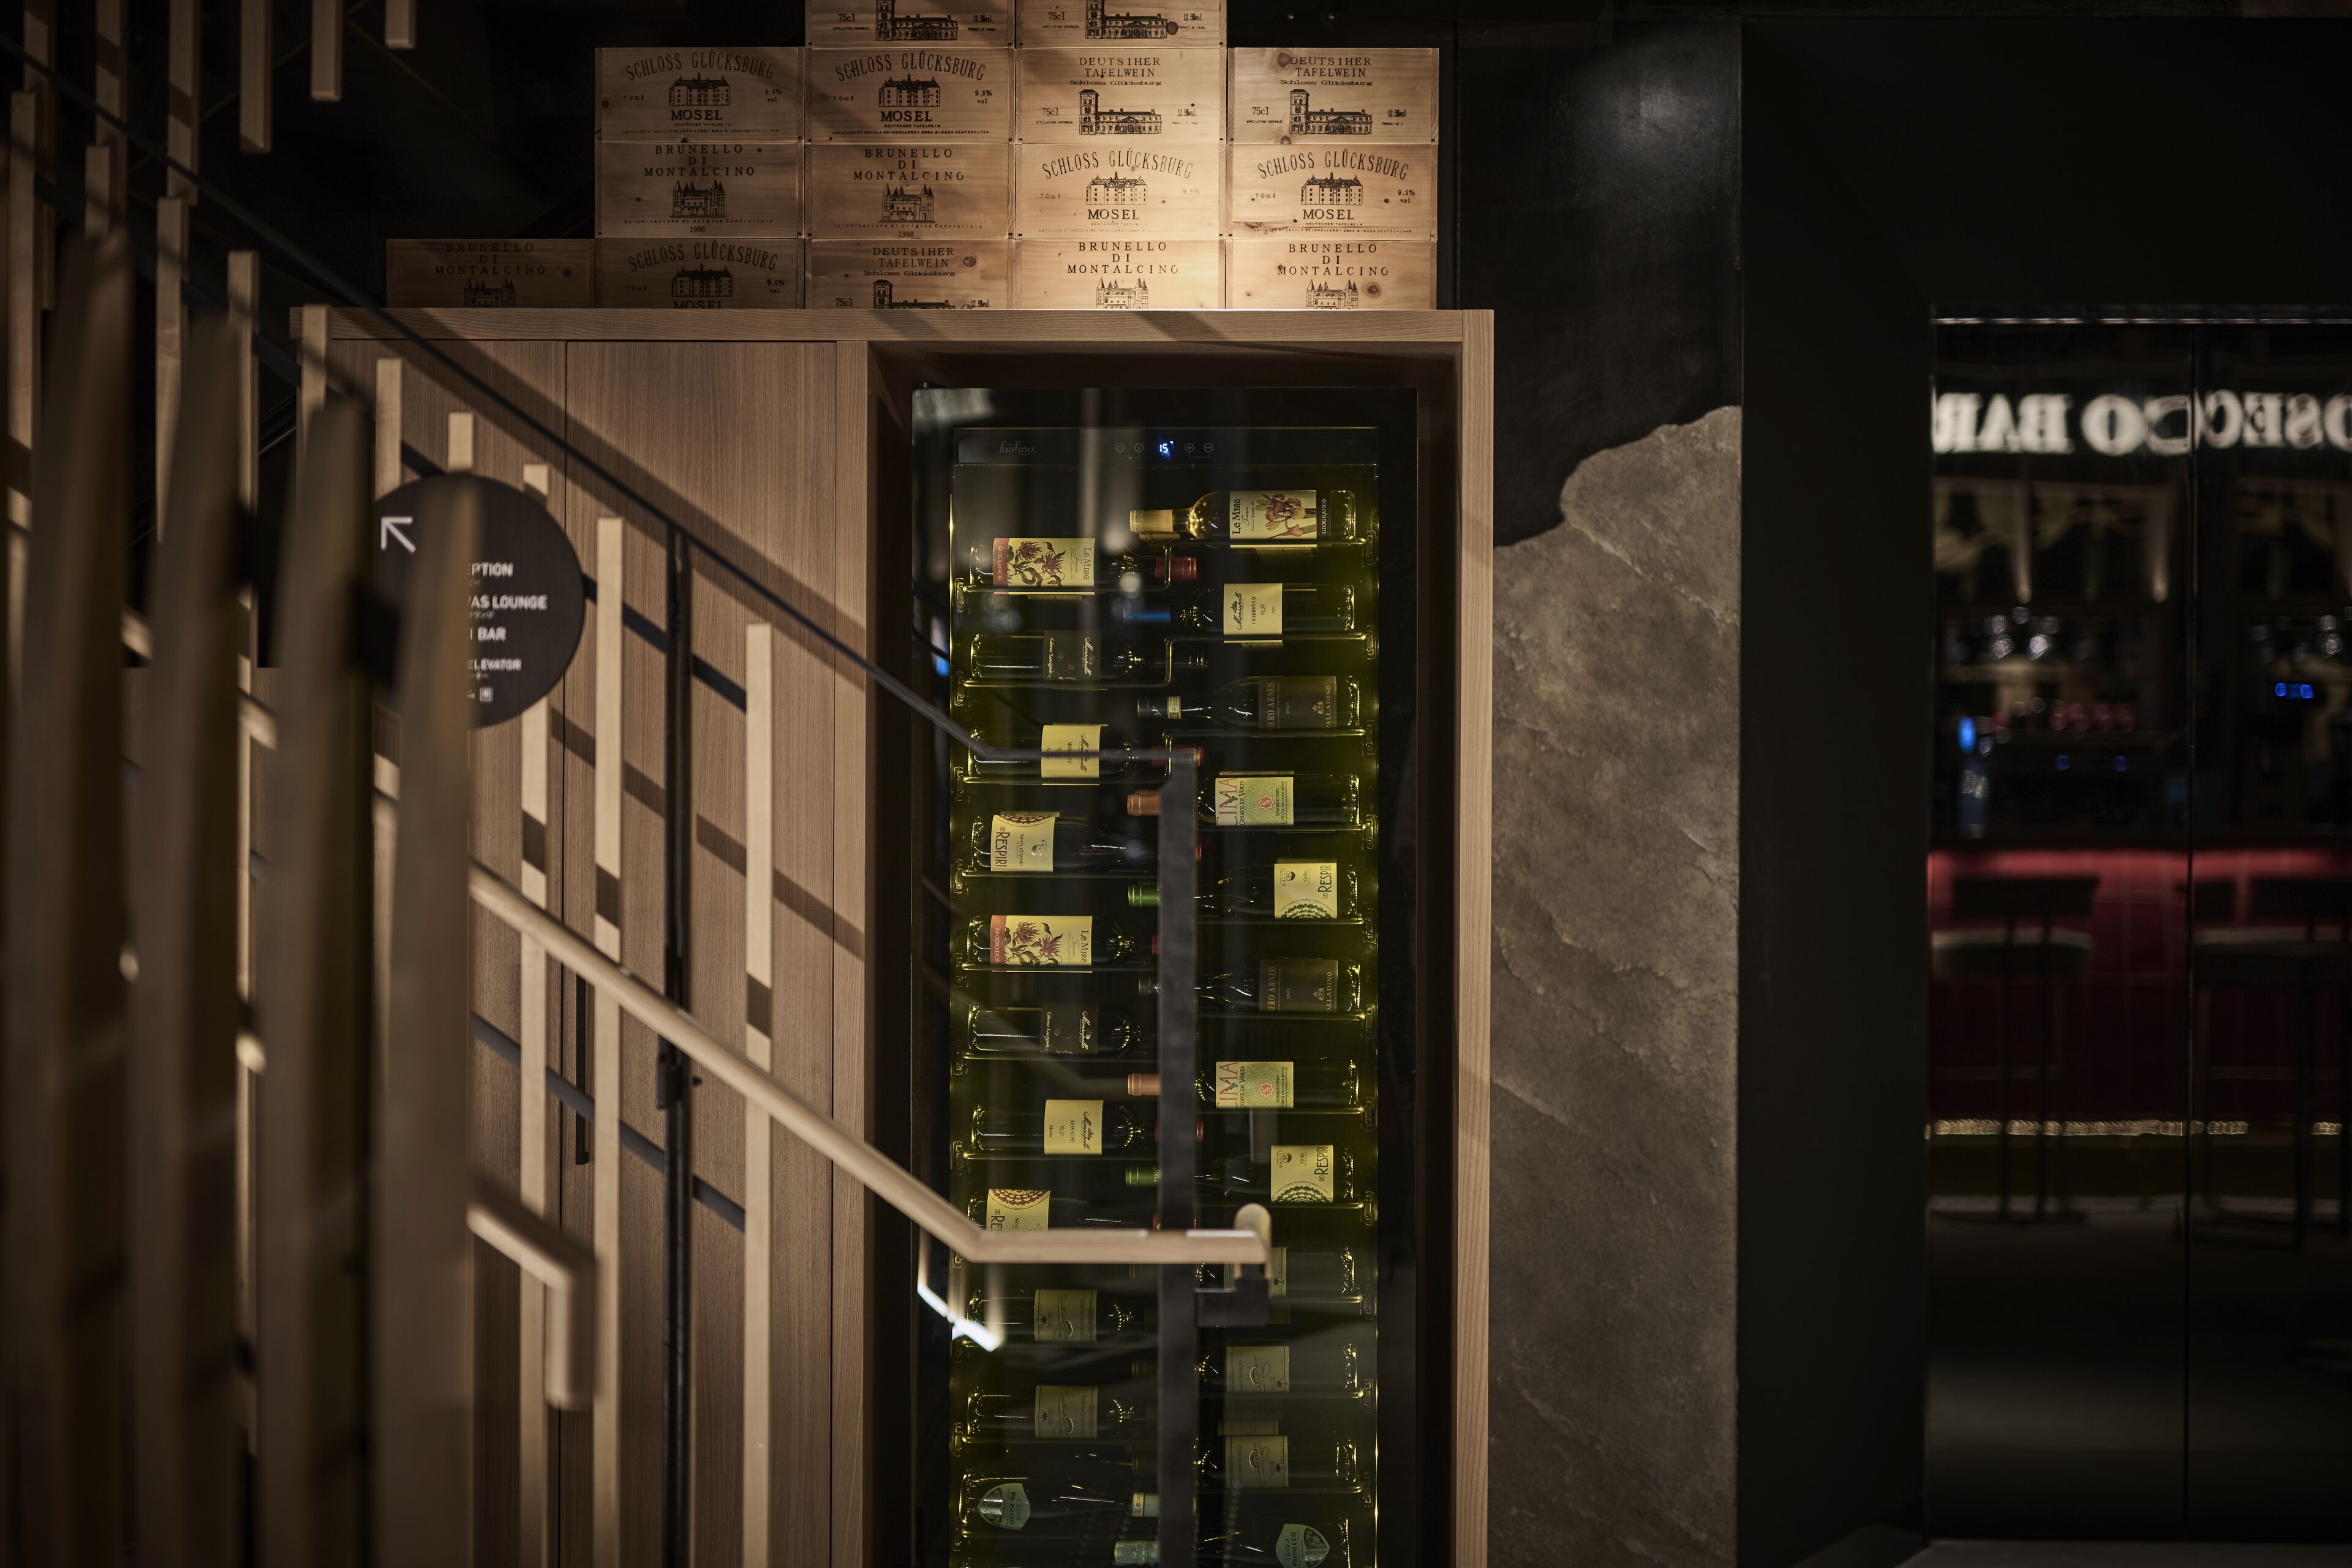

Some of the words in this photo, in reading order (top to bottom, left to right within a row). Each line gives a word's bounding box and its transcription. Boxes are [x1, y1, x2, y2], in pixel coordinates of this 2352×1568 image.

[839, 13, 855, 22] 75cl
[1048, 12, 1065, 20] 75cl
[626, 53, 682, 81] SCHLOSS
[692, 49, 775, 79] GLÜCKSBURG
[835, 53, 892, 81] SCHLOSS
[902, 50, 986, 81] GLÜCKSBURG
[1079, 57, 1160, 66] DEUTSIHER
[1290, 57, 1371, 66] DEUTSIHER
[1085, 68, 1155, 78] TAFELWEIN
[1295, 67, 1366, 77] TAFELWEIN
[671, 110, 723, 121] MOSEL
[881, 111, 932, 121] MOSEL
[1042, 107, 1059, 116] 75cl
[1252, 107, 1270, 116] 75cl
[655, 145, 742, 154] BRUNELLO
[865, 148, 952, 157] BRUNELLO
[688, 156, 706, 165] DI
[898, 160, 916, 169] DI
[1042, 151, 1099, 179] SCHLOSS
[1109, 148, 1193, 179] GLÜCKSBURG
[1257, 152, 1314, 179] SCHLOSS
[1325, 148, 1408, 180] GLÜCKSBURG
[644, 167, 755, 176] MONTALCINO
[853, 171, 964, 181] MONTALCINO
[1087, 209, 1139, 220] MOSEL
[1303, 208, 1354, 220] MOSEL
[446, 243, 533, 252] BRUNELLO
[1079, 241, 1167, 251] BRUNELLO
[1288, 243, 1377, 253] BRUNELLO
[628, 244, 684, 272] SCHLOSS
[695, 239, 778, 270] GLÜCKSBURG
[873, 247, 954, 256] DEUTSIHER
[480, 254, 497, 263] DI
[879, 258, 949, 268] TAFELWEIN
[1112, 254, 1131, 263] DI
[1322, 255, 1340, 264] DI
[435, 265, 545, 274] MONTALCINO
[1067, 265, 1179, 274] MONTALCINO
[1277, 266, 1389, 276] MONTALCINO
[835, 298, 853, 307] 75cl
[468, 562, 513, 576] PTION
[492, 594, 548, 610] LOUNGE
[1233, 592, 1244, 630] Monsupello
[478, 627, 507, 641] BAR
[1082, 637, 1093, 676] Monsupello
[468, 658, 522, 671] ELEVATOR
[995, 832, 1010, 867] RESPIRI
[1079, 1011, 1090, 1050] Monsupello
[1081, 1112, 1091, 1149] Monsupello
